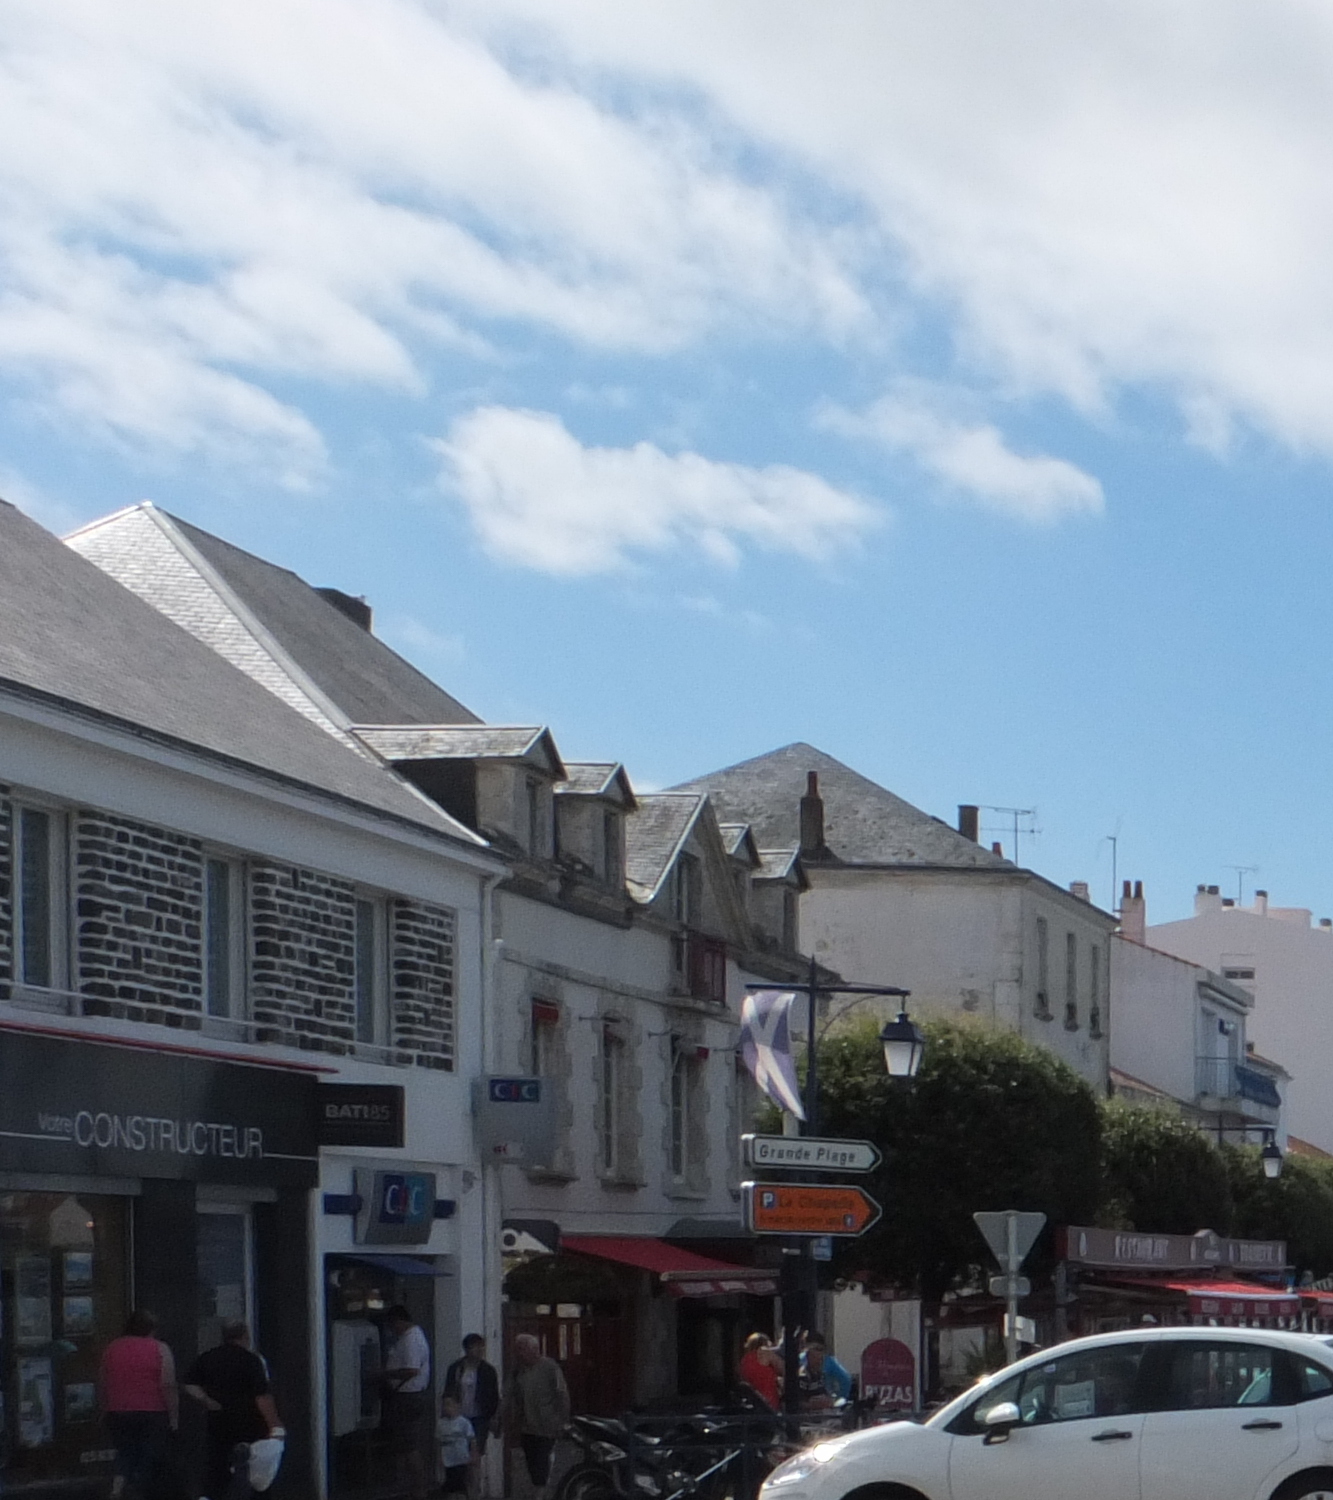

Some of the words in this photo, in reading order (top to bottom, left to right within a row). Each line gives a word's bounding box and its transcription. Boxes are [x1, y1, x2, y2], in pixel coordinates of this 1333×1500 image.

[494, 1082, 537, 1100] CIC
[74, 1110, 263, 1160] CONSTRUCTEUR
[759, 1144, 811, 1161] Grande
[816, 1147, 856, 1166] Plage
[385, 1184, 425, 1215] CIC
[763, 1192, 774, 1208] P
